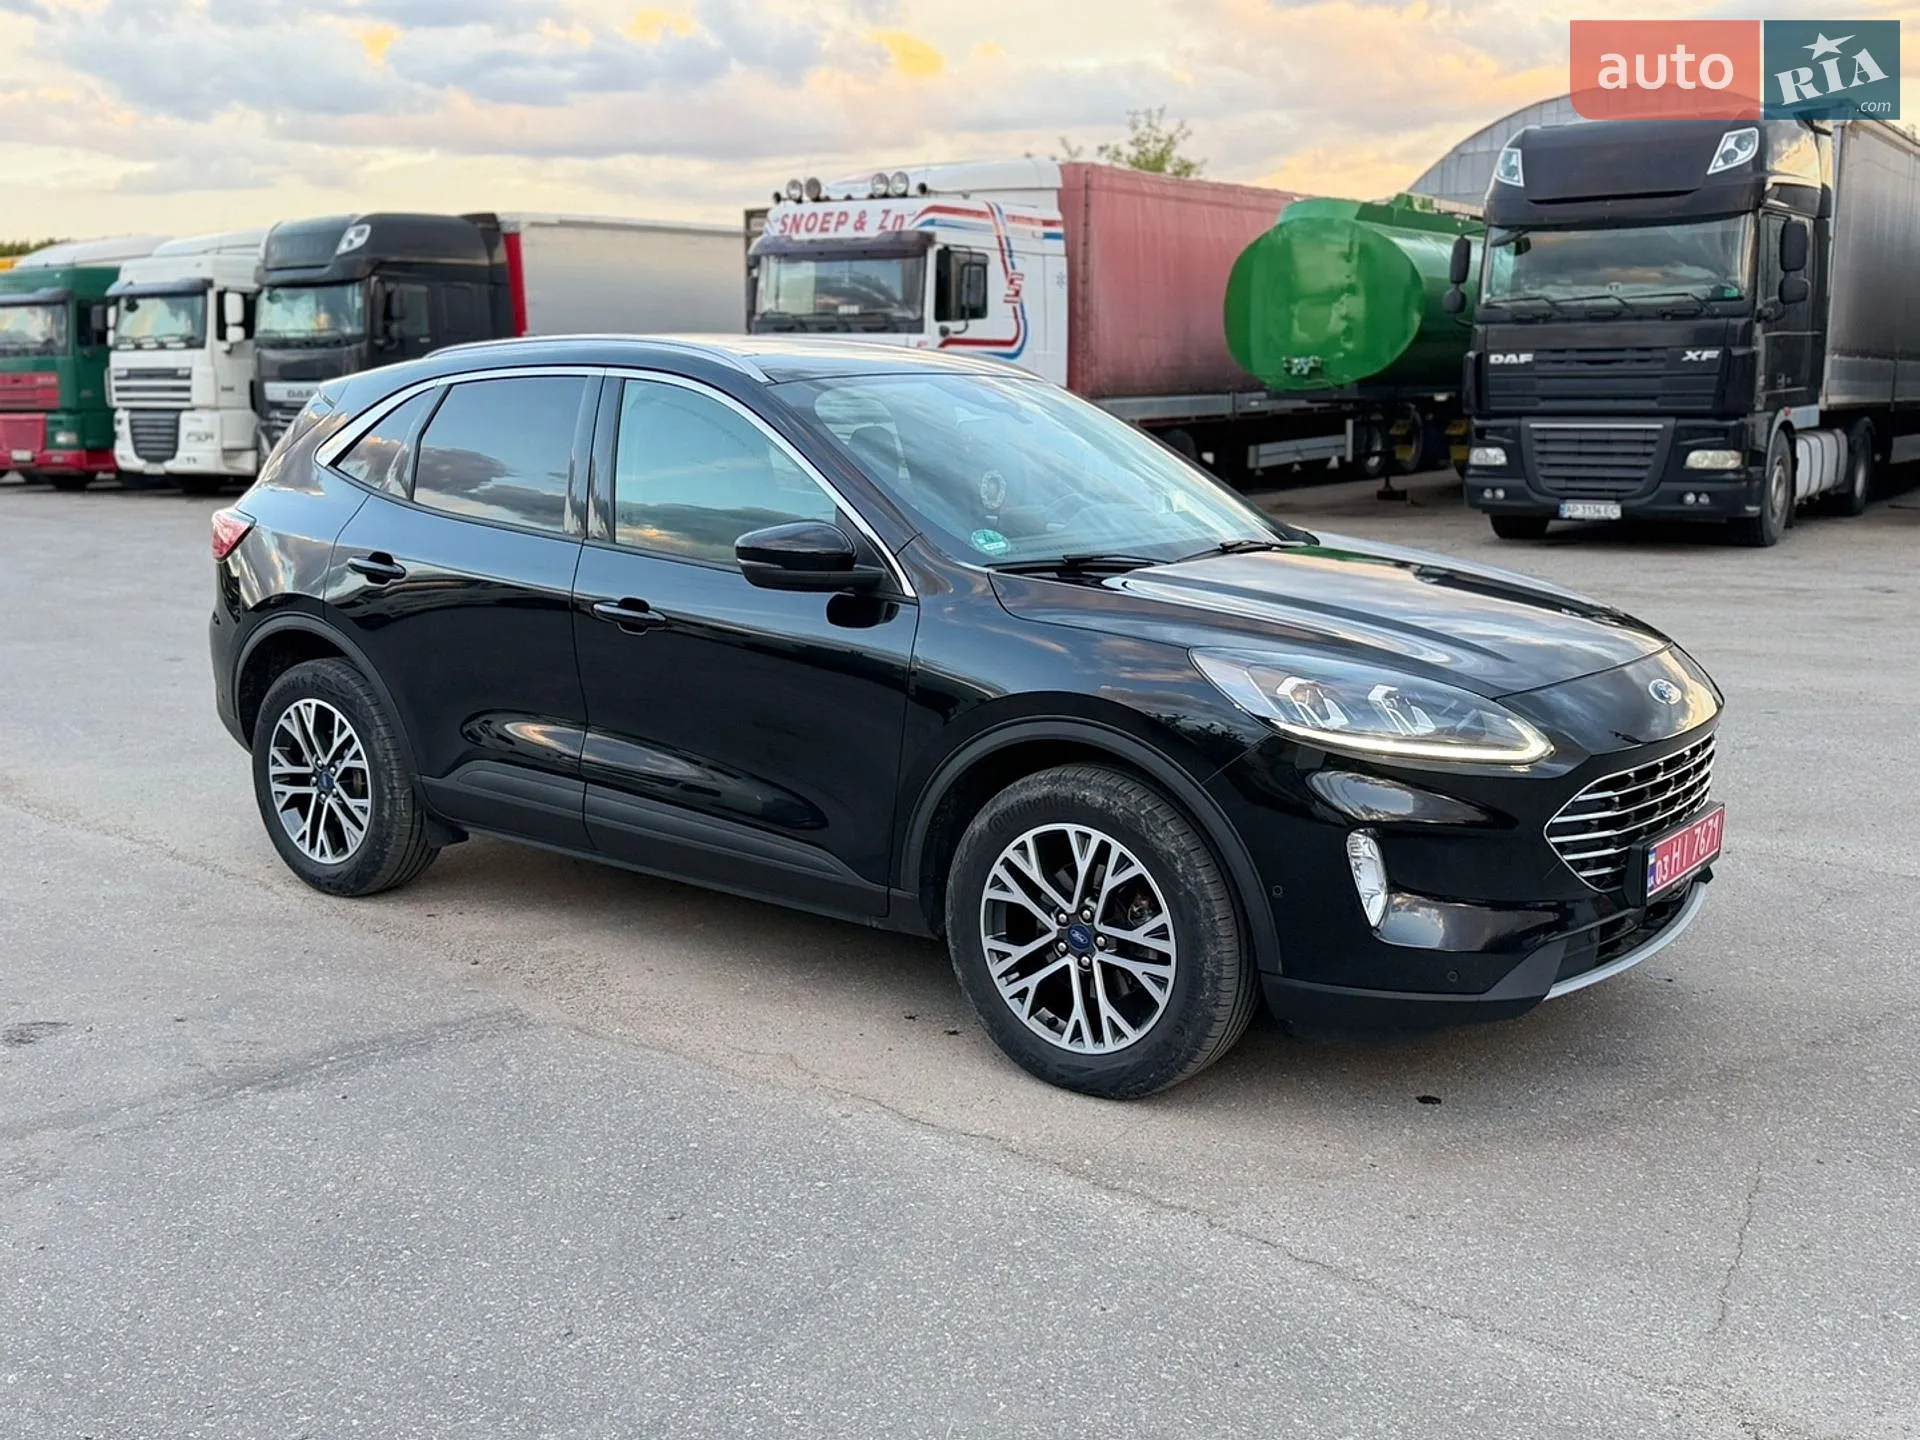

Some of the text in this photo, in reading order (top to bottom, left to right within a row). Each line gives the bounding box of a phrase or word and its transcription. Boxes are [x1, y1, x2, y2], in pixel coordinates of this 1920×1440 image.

[780, 212, 849, 234] SNOEP
[853, 210, 868, 232] &
[1488, 353, 1534, 365] DAF
[1681, 350, 1720, 362] XF
[1655, 854, 1670, 886] 03
